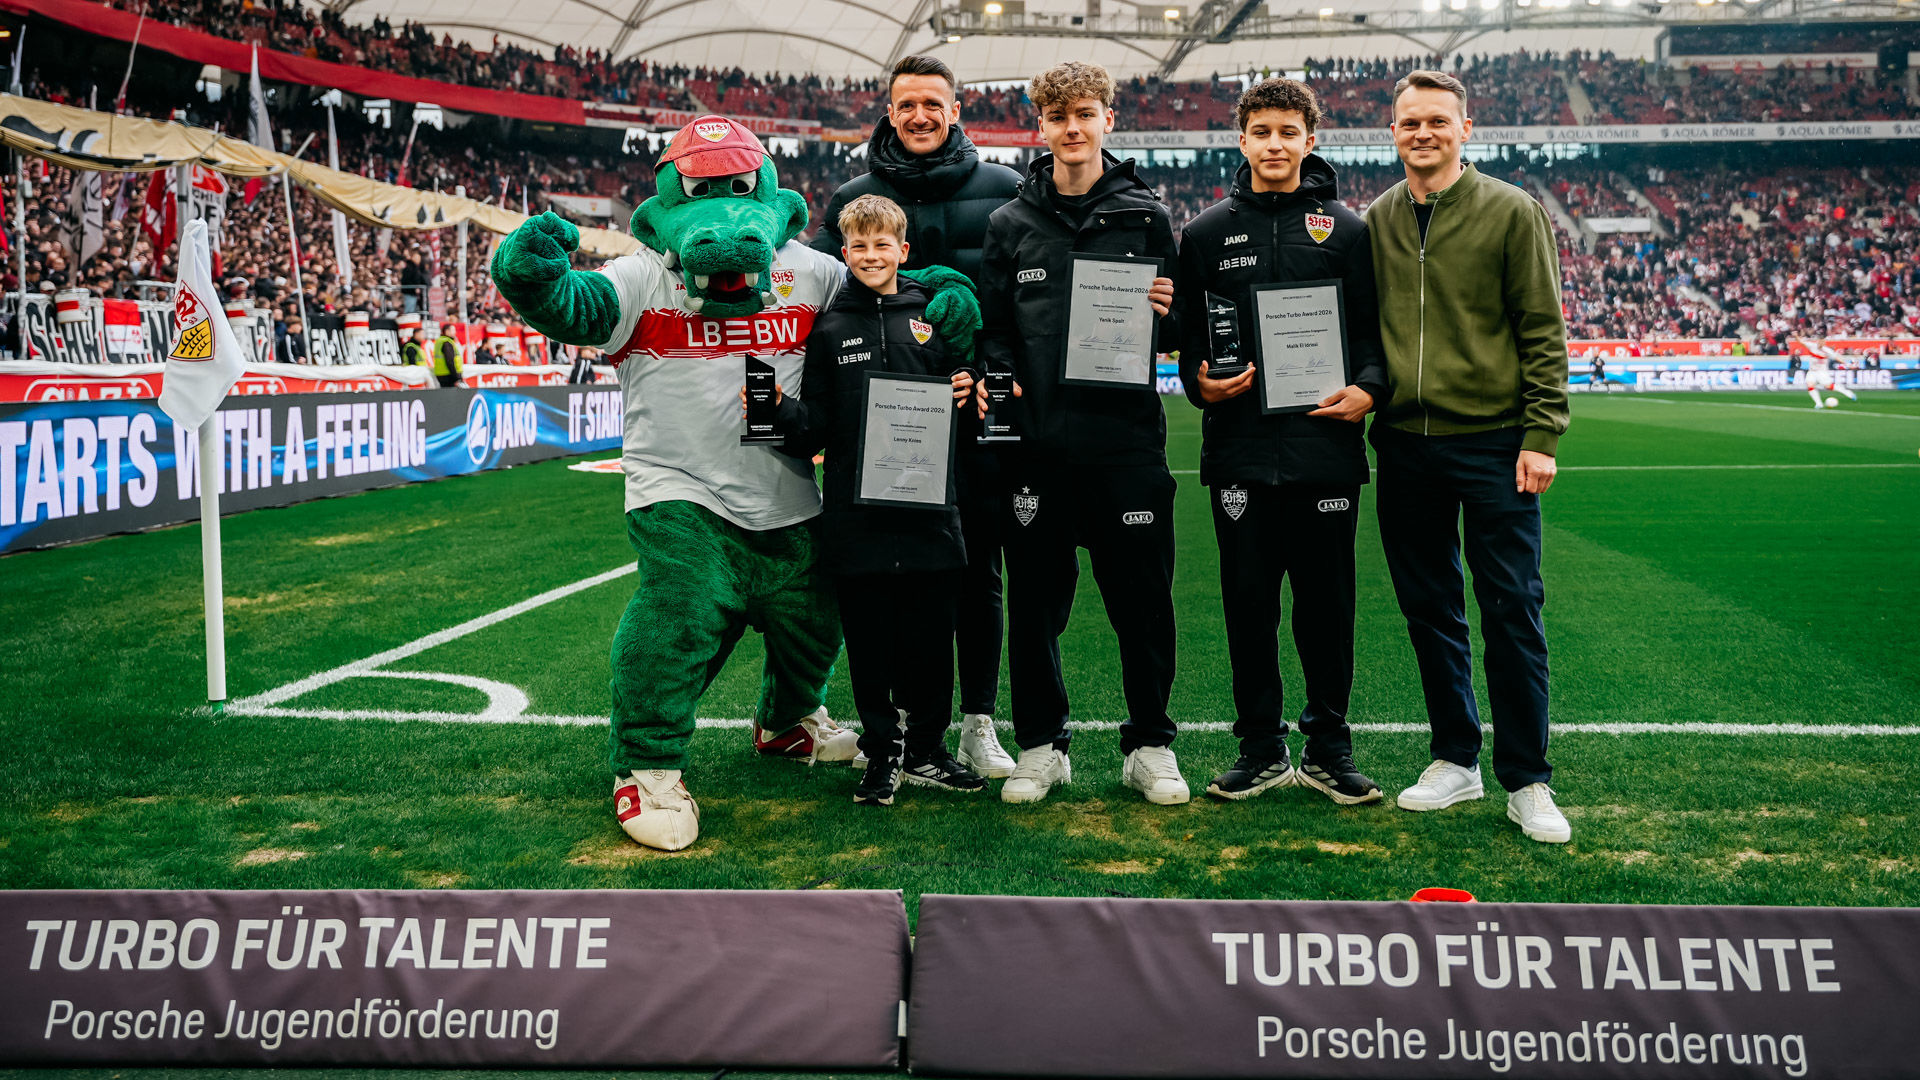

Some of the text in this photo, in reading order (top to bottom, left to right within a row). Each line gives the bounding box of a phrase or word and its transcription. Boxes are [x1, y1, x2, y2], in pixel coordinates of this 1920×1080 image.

[1558, 129, 1593, 142] AQUA
[1672, 127, 1708, 139] AQUA
[1788, 125, 1824, 137] AQUA
[1106, 134, 1141, 147] AQUA
[1224, 234, 1248, 246] JAKO
[841, 337, 863, 348] JAKO
[1660, 371, 1732, 389] STARTS
[874, 402, 897, 410] Porsche
[912, 405, 930, 413] Award
[568, 393, 583, 443] IT
[493, 400, 538, 451] JAKO
[282, 406, 309, 485] A
[316, 399, 426, 480] FEELING
[1321, 500, 1348, 511] JAKO
[1126, 513, 1152, 523] JAKO
[26, 905, 611, 970] TURBO FÜR TALENTE
[1211, 921, 1841, 992] TURBO FÜR TALENTE
[44, 998, 559, 1050] Porsche Jugendförderung
[1257, 1016, 1808, 1077] Porsche Jugendförderung
